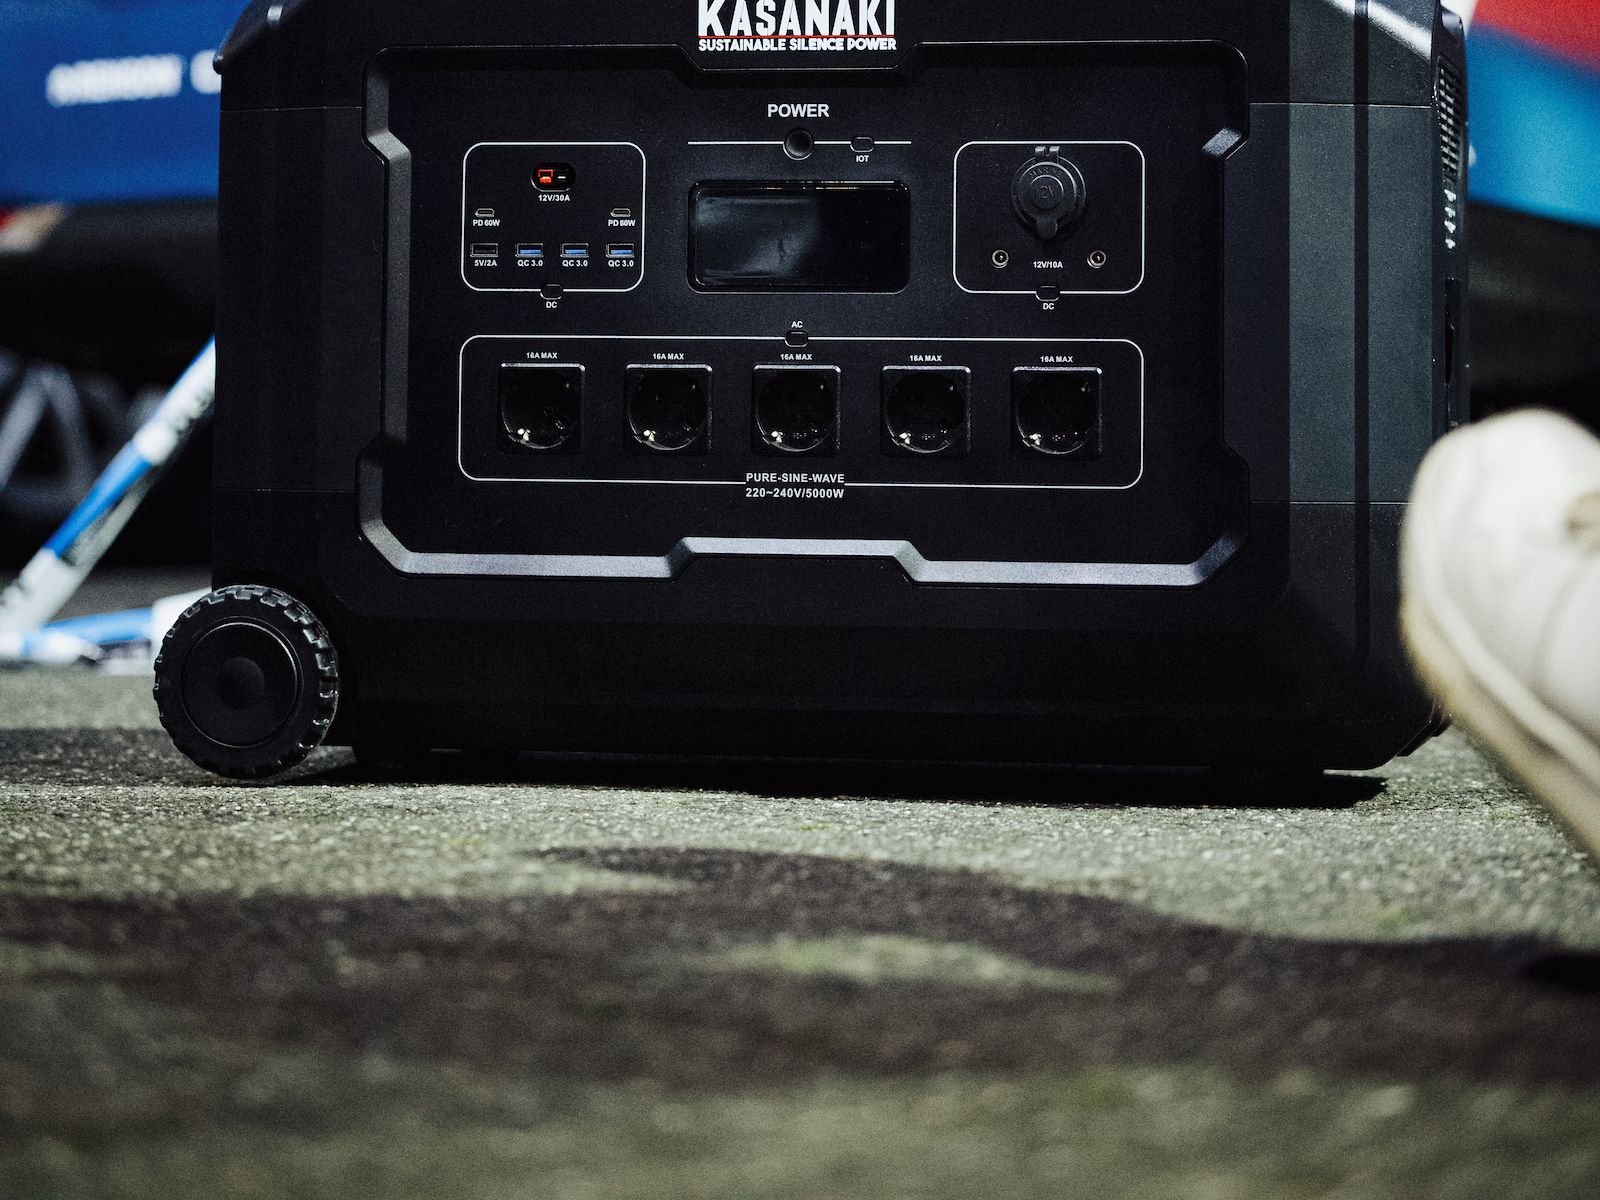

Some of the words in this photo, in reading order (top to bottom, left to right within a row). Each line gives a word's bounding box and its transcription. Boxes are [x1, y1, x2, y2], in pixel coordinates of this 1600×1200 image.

[698, 38, 786, 51] SUSTAINABLE
[789, 38, 844, 51] SILENCE
[847, 38, 897, 50] POWER
[768, 104, 829, 117] POWER
[856, 154, 869, 163] IOT
[539, 193, 570, 202] 12V/30A
[473, 218, 483, 227] PD
[484, 218, 500, 227] 60W
[608, 218, 619, 227] PD
[620, 219, 635, 227] 60W
[474, 259, 497, 267] 5V/2A
[518, 259, 529, 268] QC
[531, 259, 543, 267] 3.0
[562, 259, 574, 268] QC
[576, 259, 588, 268] 3.0
[608, 259, 620, 268] QC
[622, 259, 634, 268] 3.0
[1033, 260, 1063, 269] 12V/10A
[546, 300, 557, 309] DC
[1043, 302, 1054, 311] DC
[791, 320, 803, 329] AC
[527, 351, 540, 360] 16A
[541, 351, 557, 360] MAX
[653, 352, 666, 361] 16A
[668, 352, 684, 361] MAX
[780, 353, 794, 361] 16A
[796, 353, 812, 361] MAX
[910, 354, 923, 362] 16A
[923, 354, 942, 362] MAX
[1040, 355, 1054, 363] 16A
[1054, 355, 1073, 363] MAX
[746, 473, 844, 483] PURE-SINE-WAVE
[746, 488, 844, 498] 220~240V/5000W
